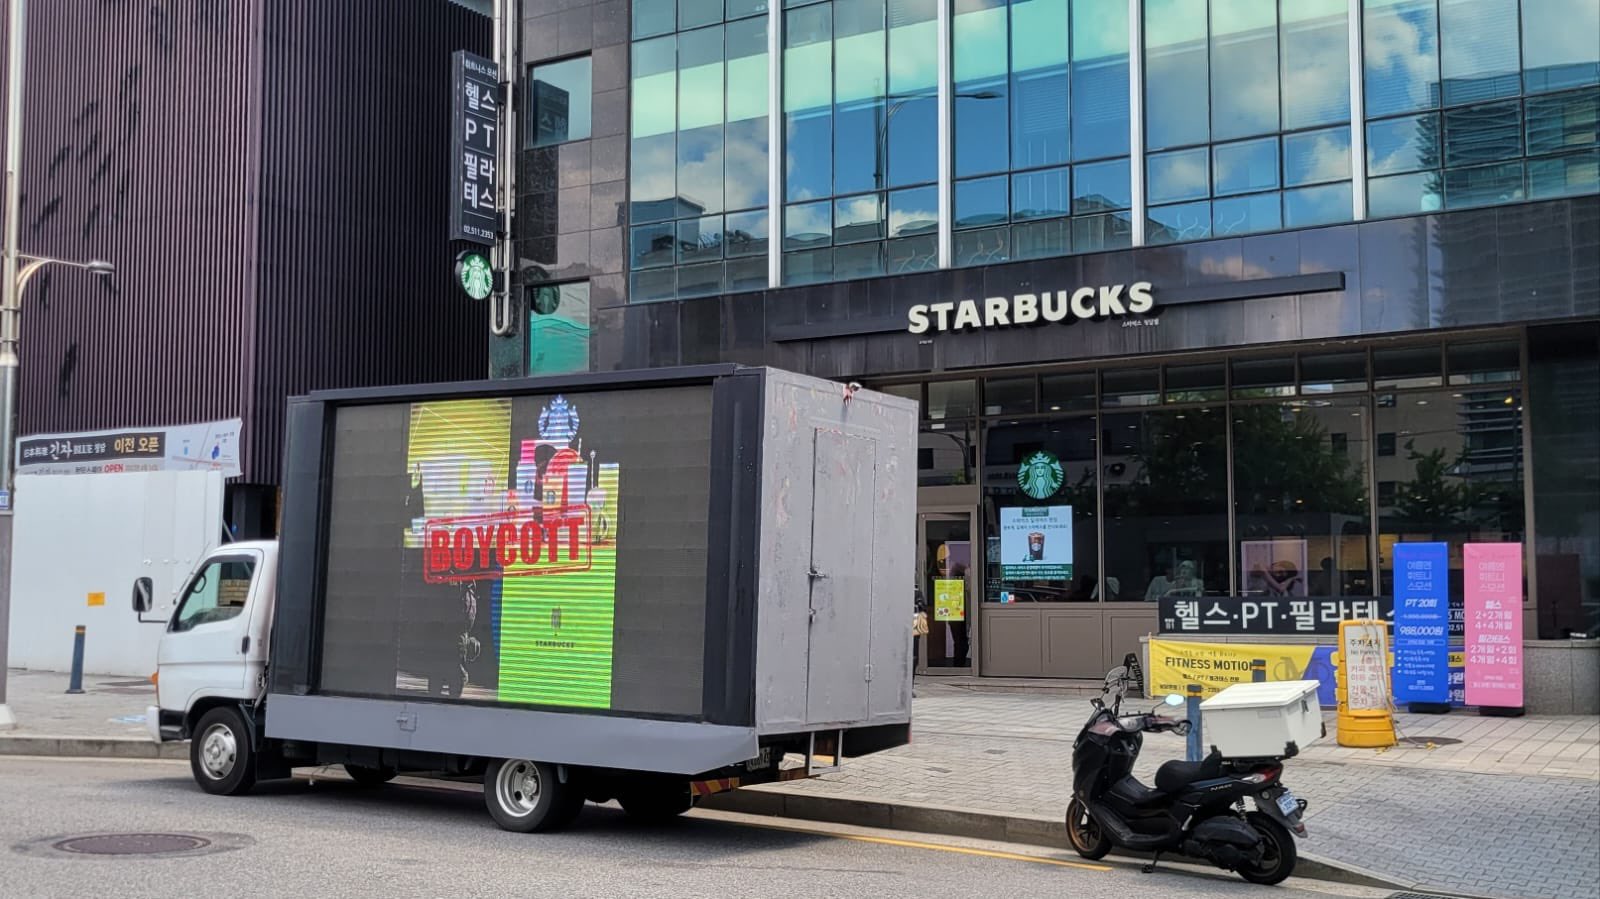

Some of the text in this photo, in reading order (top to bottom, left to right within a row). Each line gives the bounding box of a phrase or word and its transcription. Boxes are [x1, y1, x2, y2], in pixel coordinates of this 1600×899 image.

[465, 82, 496, 111] 헬스
[465, 118, 495, 148] PT
[907, 281, 1154, 334] STARBUCKS
[114, 437, 134, 454] 이전
[137, 436, 160, 452] 오픈
[104, 463, 124, 473] OPEN
[430, 517, 585, 572] BOYCOTT
[1405, 599, 1417, 608] PT
[1165, 656, 1211, 669] FITNESS
